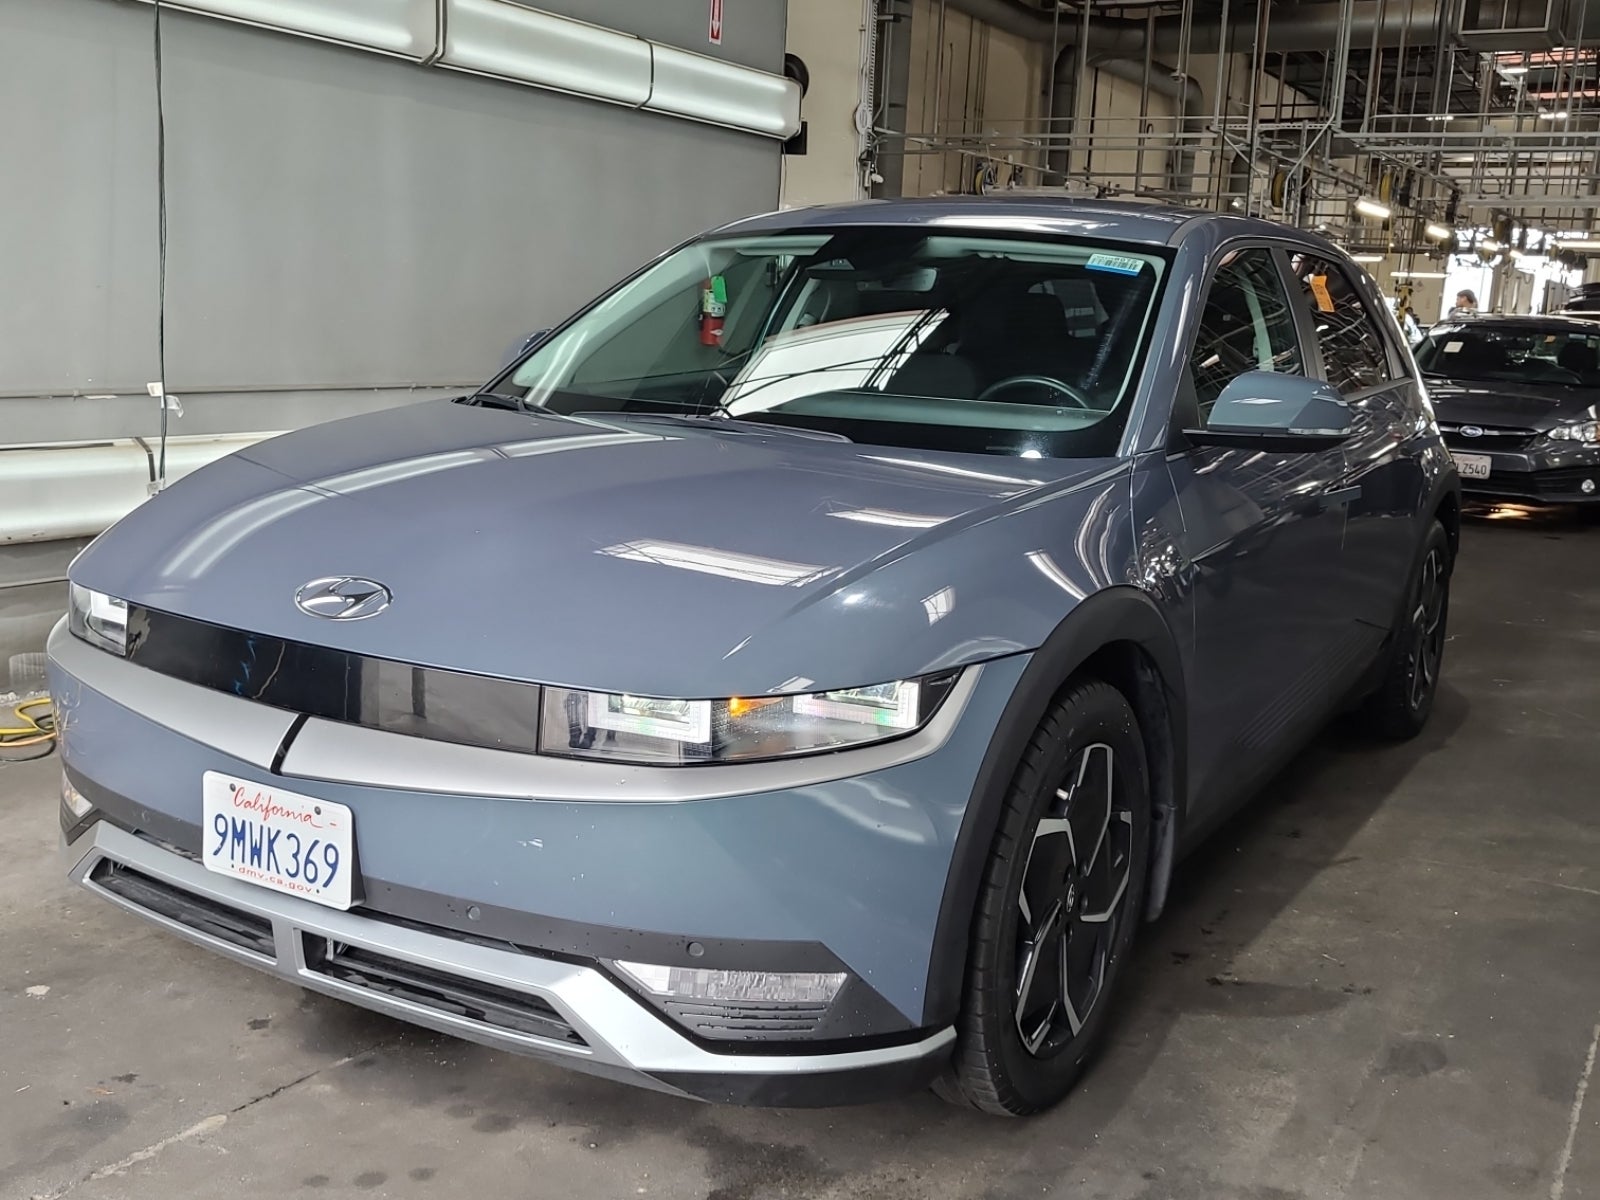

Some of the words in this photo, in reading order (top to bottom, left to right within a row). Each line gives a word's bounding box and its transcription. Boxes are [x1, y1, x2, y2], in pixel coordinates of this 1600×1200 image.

[233, 787, 323, 828] California
[213, 813, 340, 888] 9MWK369
[238, 867, 312, 893] dmv.ca.gov
